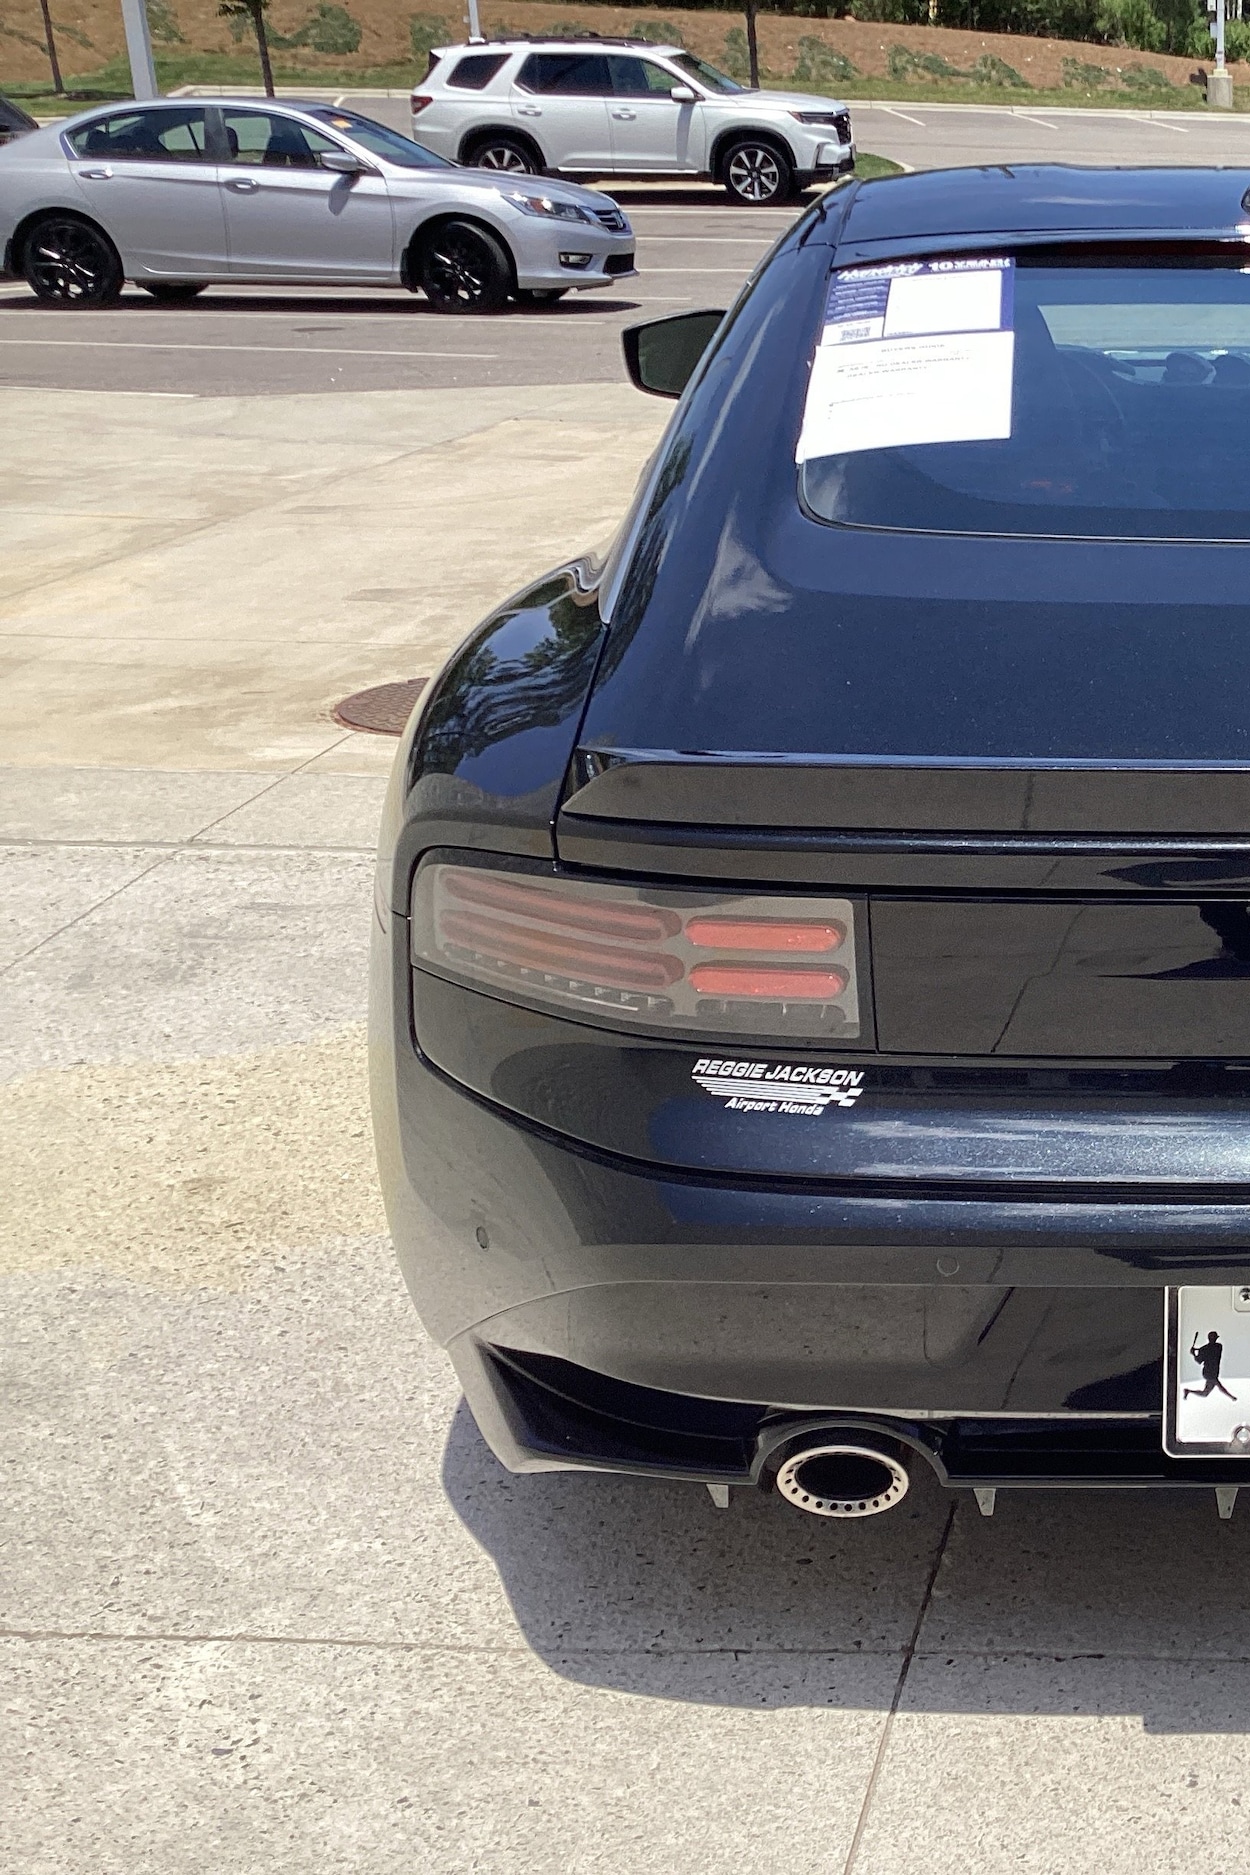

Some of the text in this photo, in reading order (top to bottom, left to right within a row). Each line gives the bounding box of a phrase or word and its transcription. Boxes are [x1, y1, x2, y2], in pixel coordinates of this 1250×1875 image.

[691, 1058, 865, 1086] REGGIE JACKSON
[724, 1097, 825, 1116] Airport Honda
